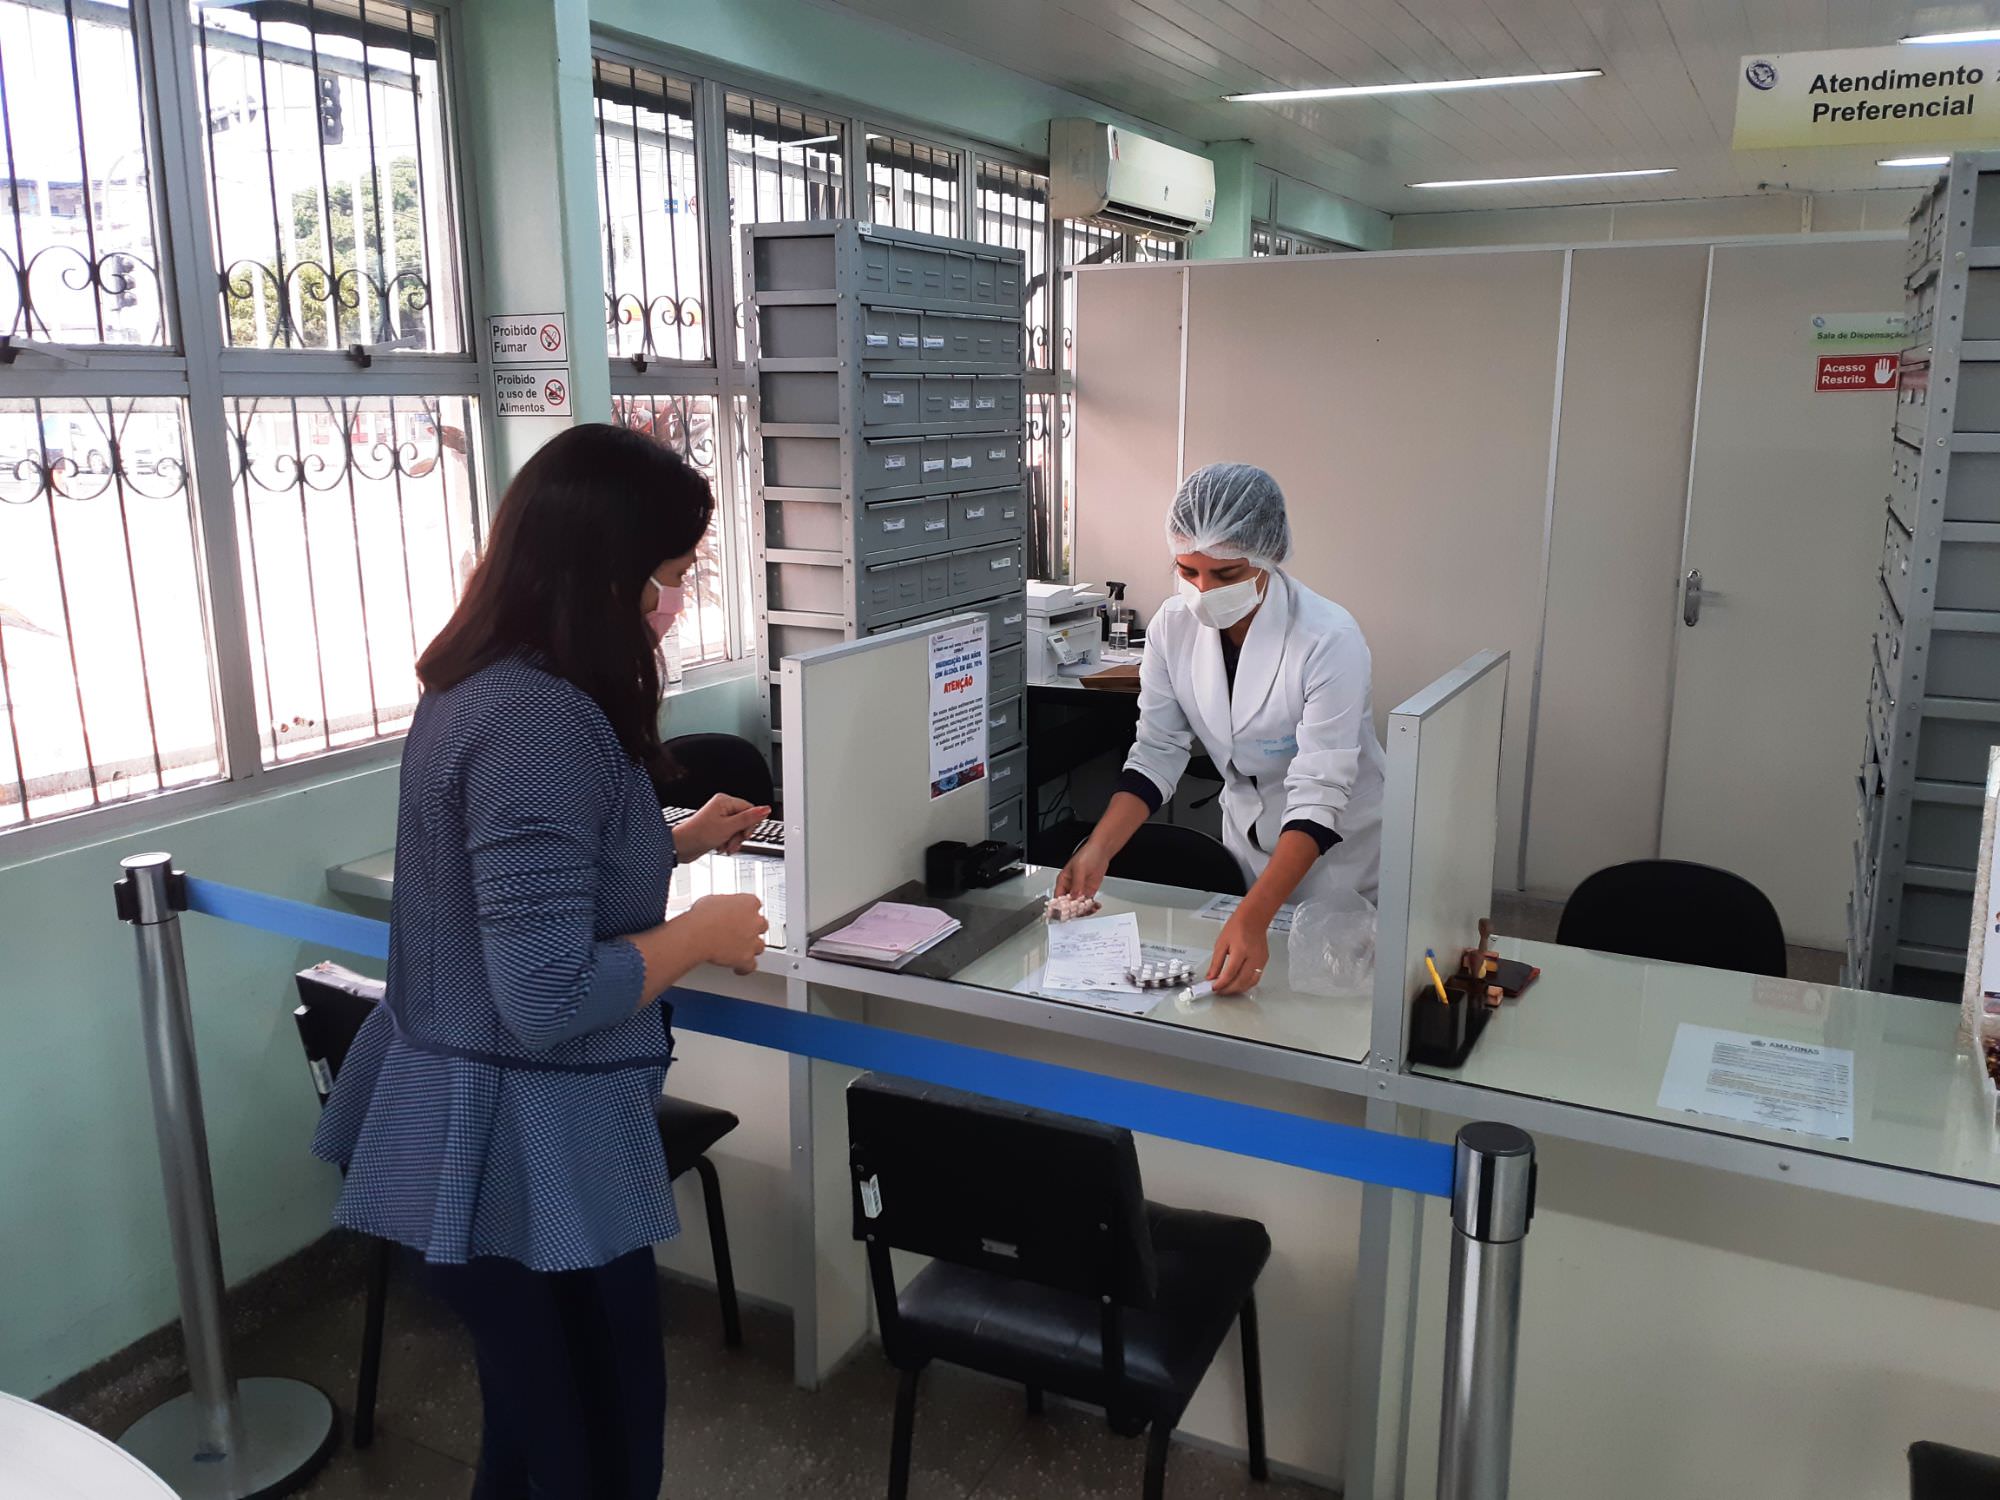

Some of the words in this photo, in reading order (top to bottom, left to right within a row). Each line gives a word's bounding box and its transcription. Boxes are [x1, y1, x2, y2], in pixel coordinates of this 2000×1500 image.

[1808, 65, 1984, 94] Atendimento
[1812, 94, 1975, 123] Preferencial
[492, 325, 536, 336] Proibido
[1817, 332, 1836, 340] Sala
[494, 342, 528, 352] Fumar
[1824, 364, 1866, 372] Acesso
[497, 374, 536, 384] Proibido
[1822, 375, 1866, 384] Restrito
[498, 390, 504, 398] o
[506, 390, 524, 398] uso
[526, 388, 537, 398] de
[500, 402, 545, 412] Alimentos
[944, 674, 973, 693] ATENÇÃO
